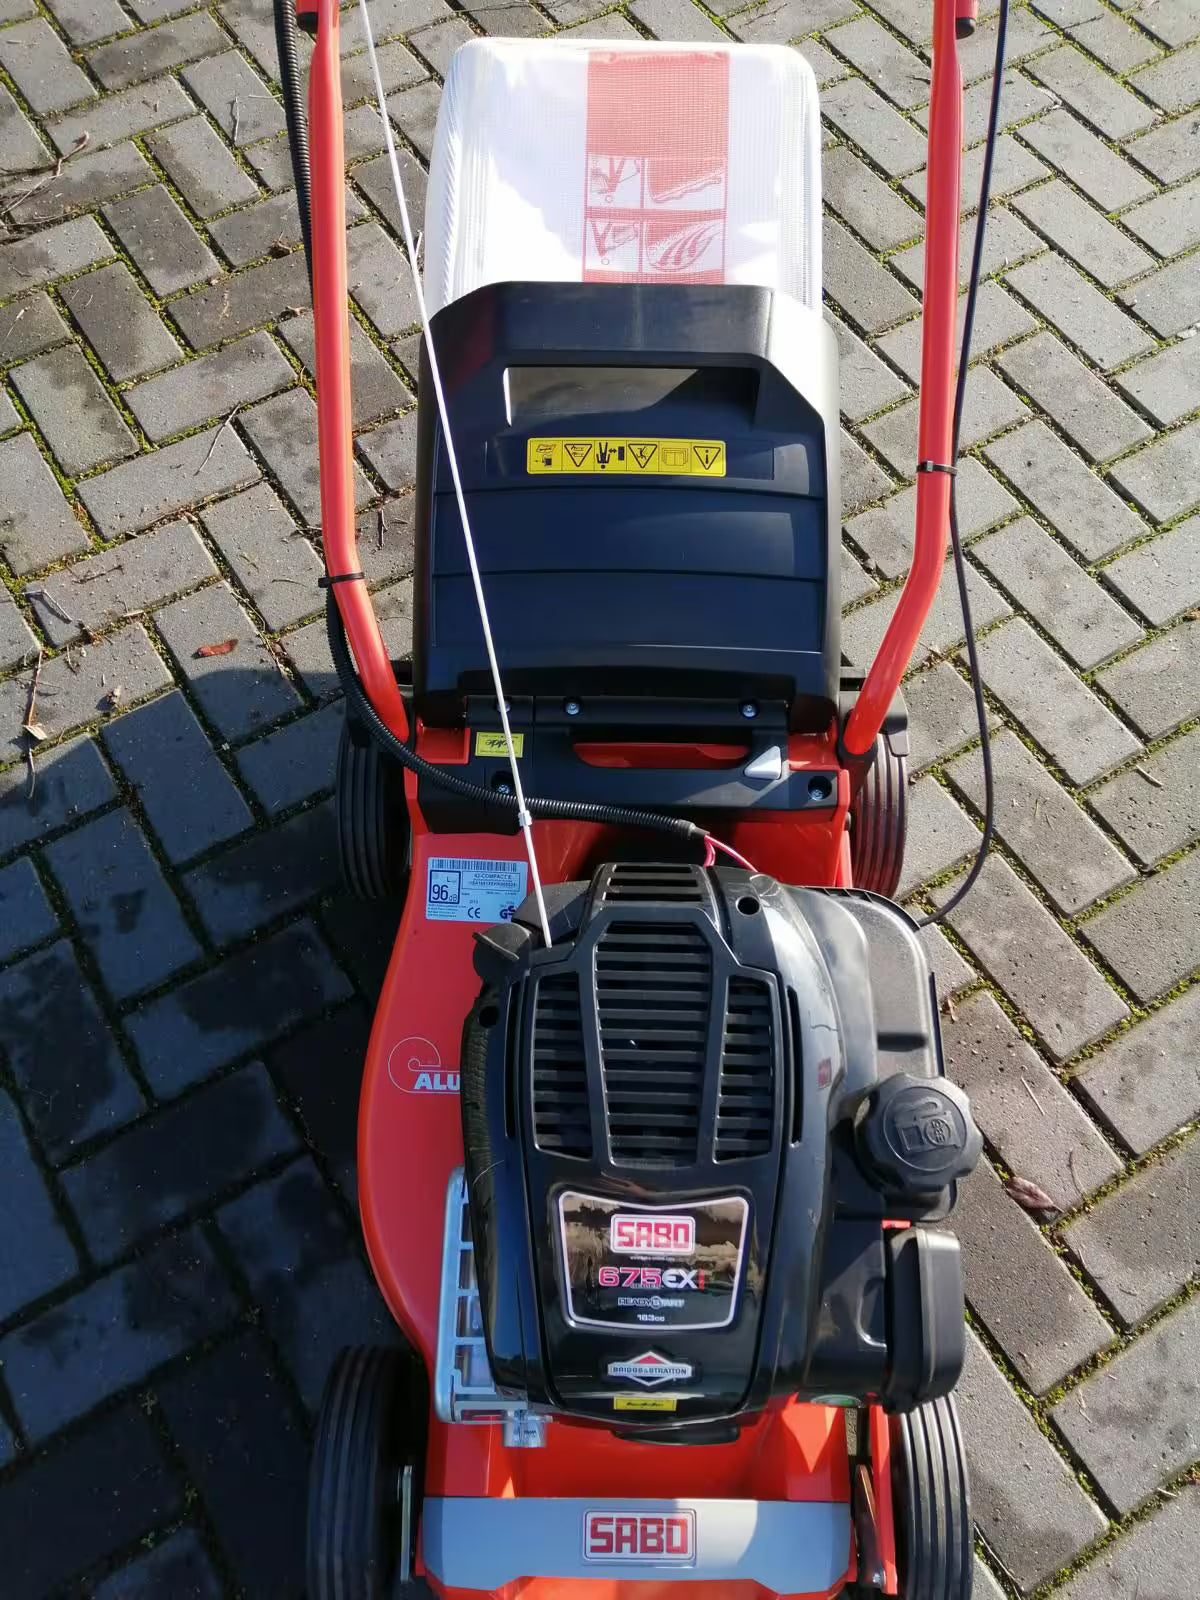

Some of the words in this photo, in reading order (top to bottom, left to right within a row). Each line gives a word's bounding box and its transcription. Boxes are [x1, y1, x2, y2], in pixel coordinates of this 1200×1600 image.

[432, 884, 448, 900] 96
[617, 1222, 689, 1249] SABO
[590, 1518, 688, 1554] SABO
